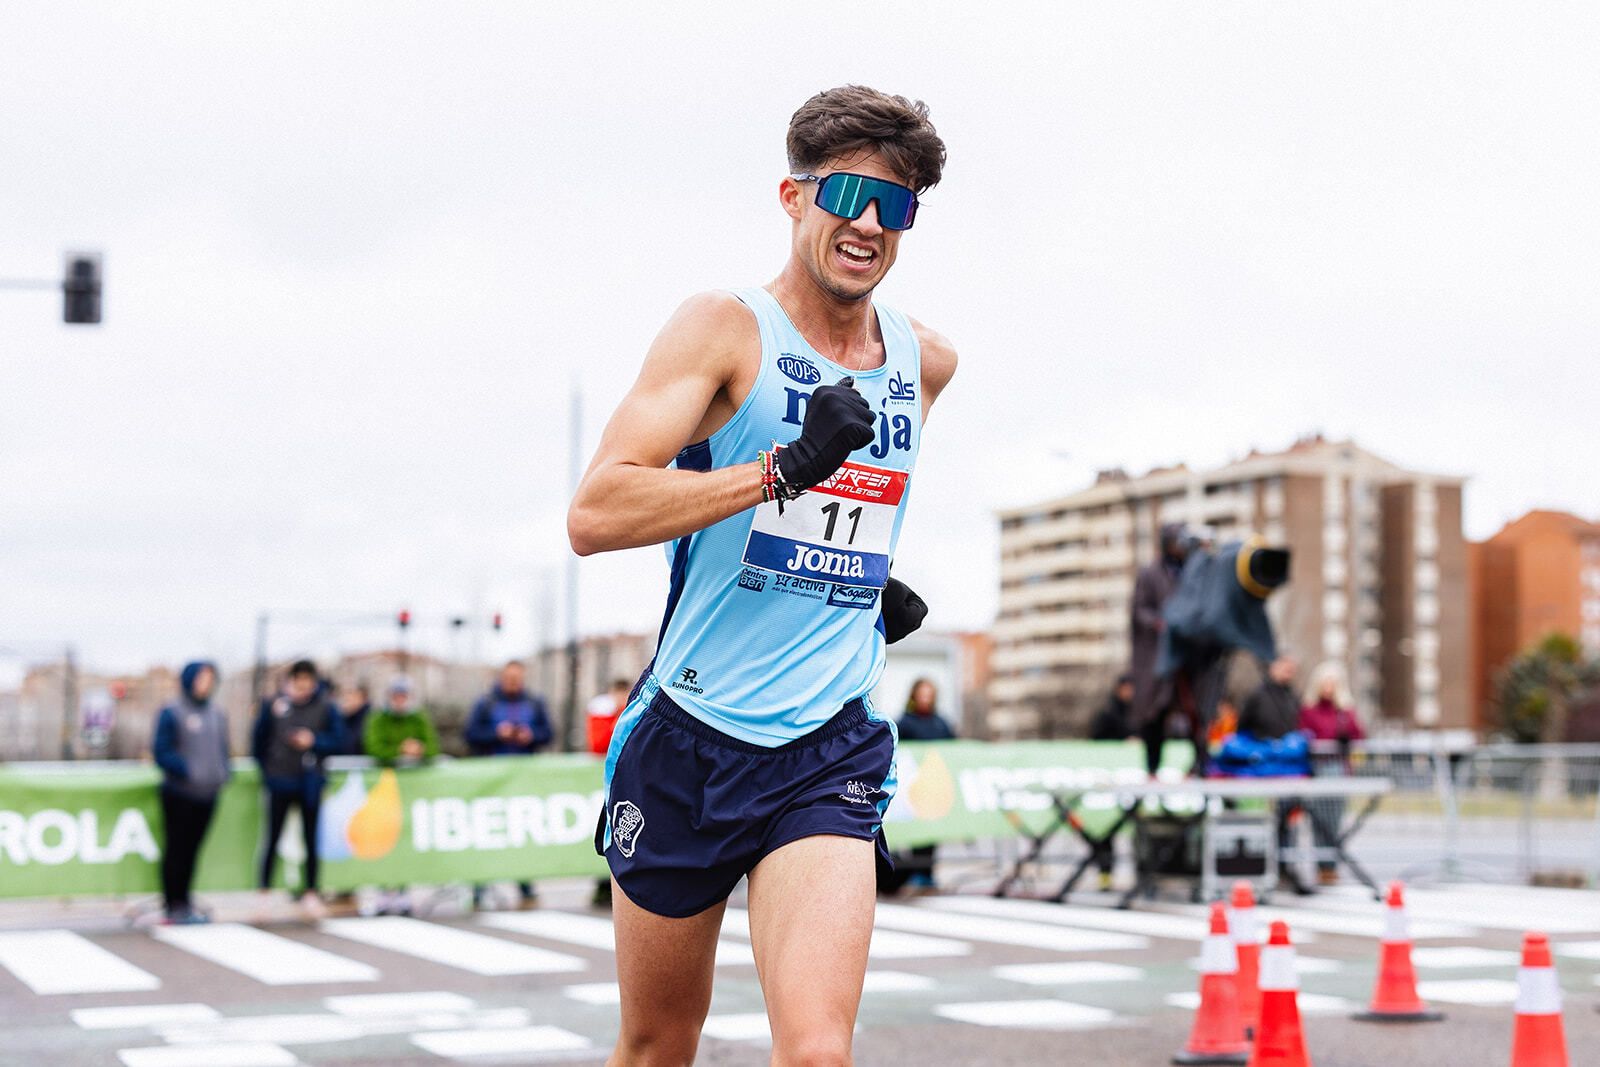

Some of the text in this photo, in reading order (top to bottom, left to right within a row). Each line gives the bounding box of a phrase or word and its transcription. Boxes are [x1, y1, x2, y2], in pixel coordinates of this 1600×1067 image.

[779, 359, 819, 381] TROPS
[782, 387, 911, 459] nja
[841, 469, 892, 488] RFEA
[821, 501, 863, 545] 11
[791, 577, 826, 593] activa
[412, 791, 604, 852] IBERD
